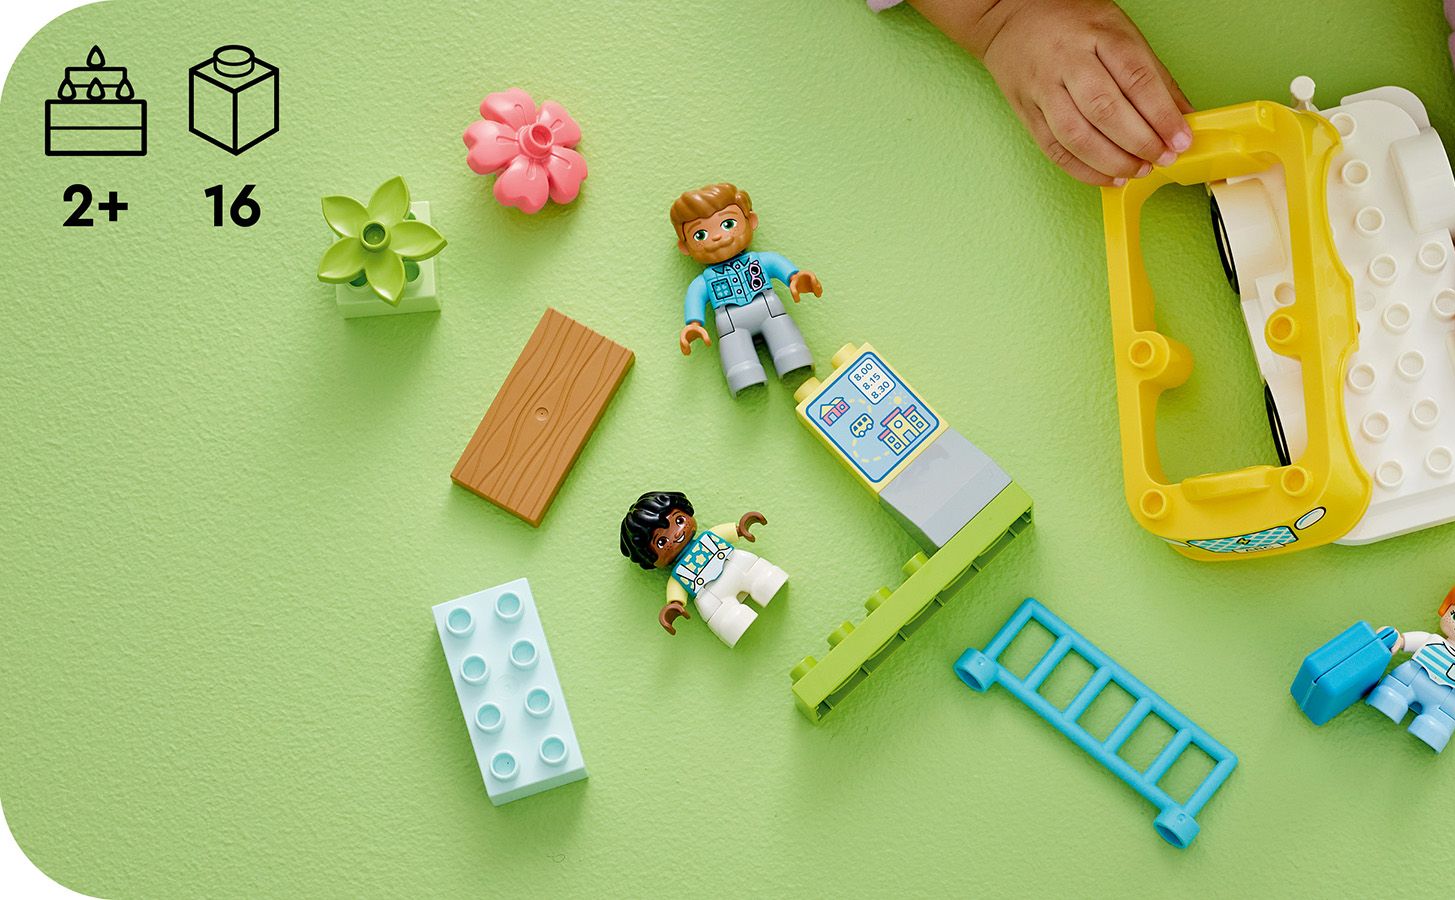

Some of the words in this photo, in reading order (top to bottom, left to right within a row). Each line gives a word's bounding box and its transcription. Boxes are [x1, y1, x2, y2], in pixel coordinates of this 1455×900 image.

[854, 363, 873, 381] 8.00
[862, 373, 881, 390] 8.15
[871, 381, 890, 399] 8.30
